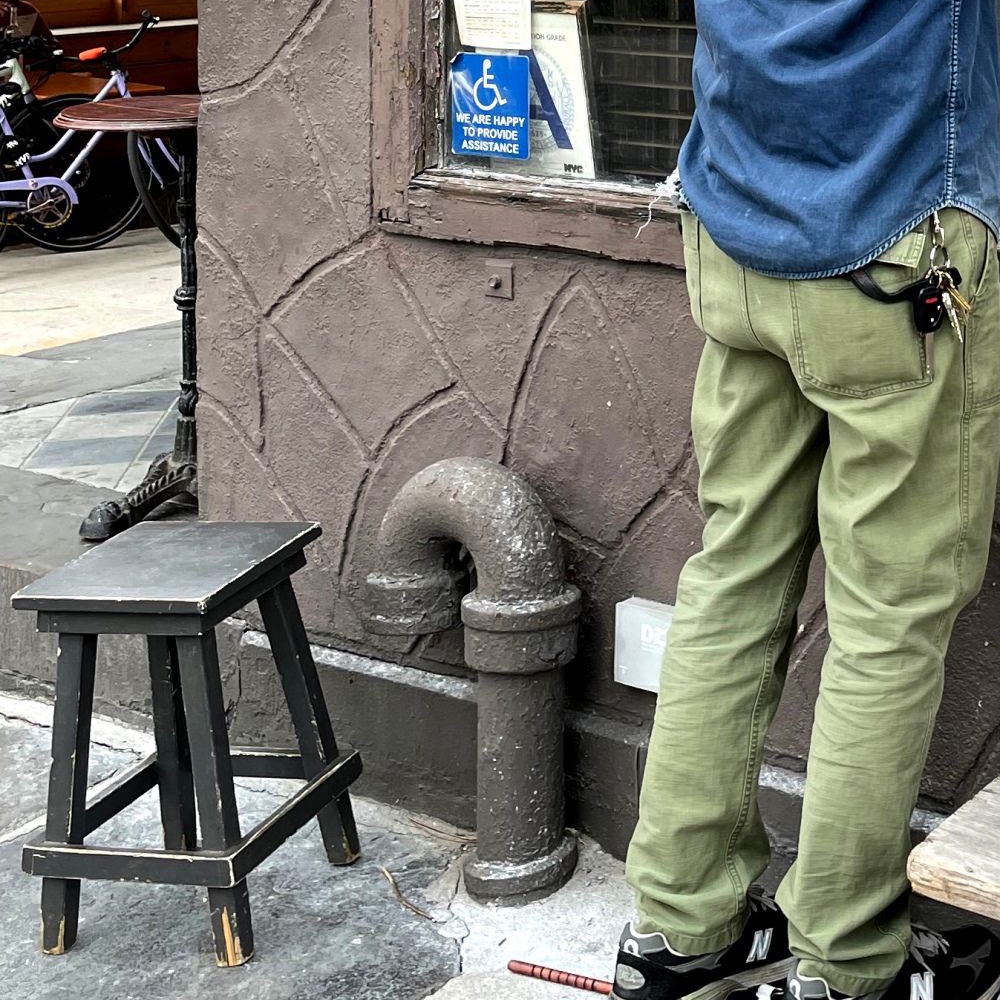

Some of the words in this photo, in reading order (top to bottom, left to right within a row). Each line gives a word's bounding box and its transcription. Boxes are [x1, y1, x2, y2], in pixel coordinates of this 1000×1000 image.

[546, 33, 566, 42] GRADE
[456, 112, 472, 123] WE
[472, 113, 492, 125] ARE
[493, 115, 525, 127] HAPPY
[462, 126, 476, 137] TO
[477, 127, 518, 141] PROVIDE
[461, 140, 519, 154] ASSISTANCE
[564, 163, 583, 173] NYC
[746, 928, 774, 963] N
[910, 971, 935, 1000] N
